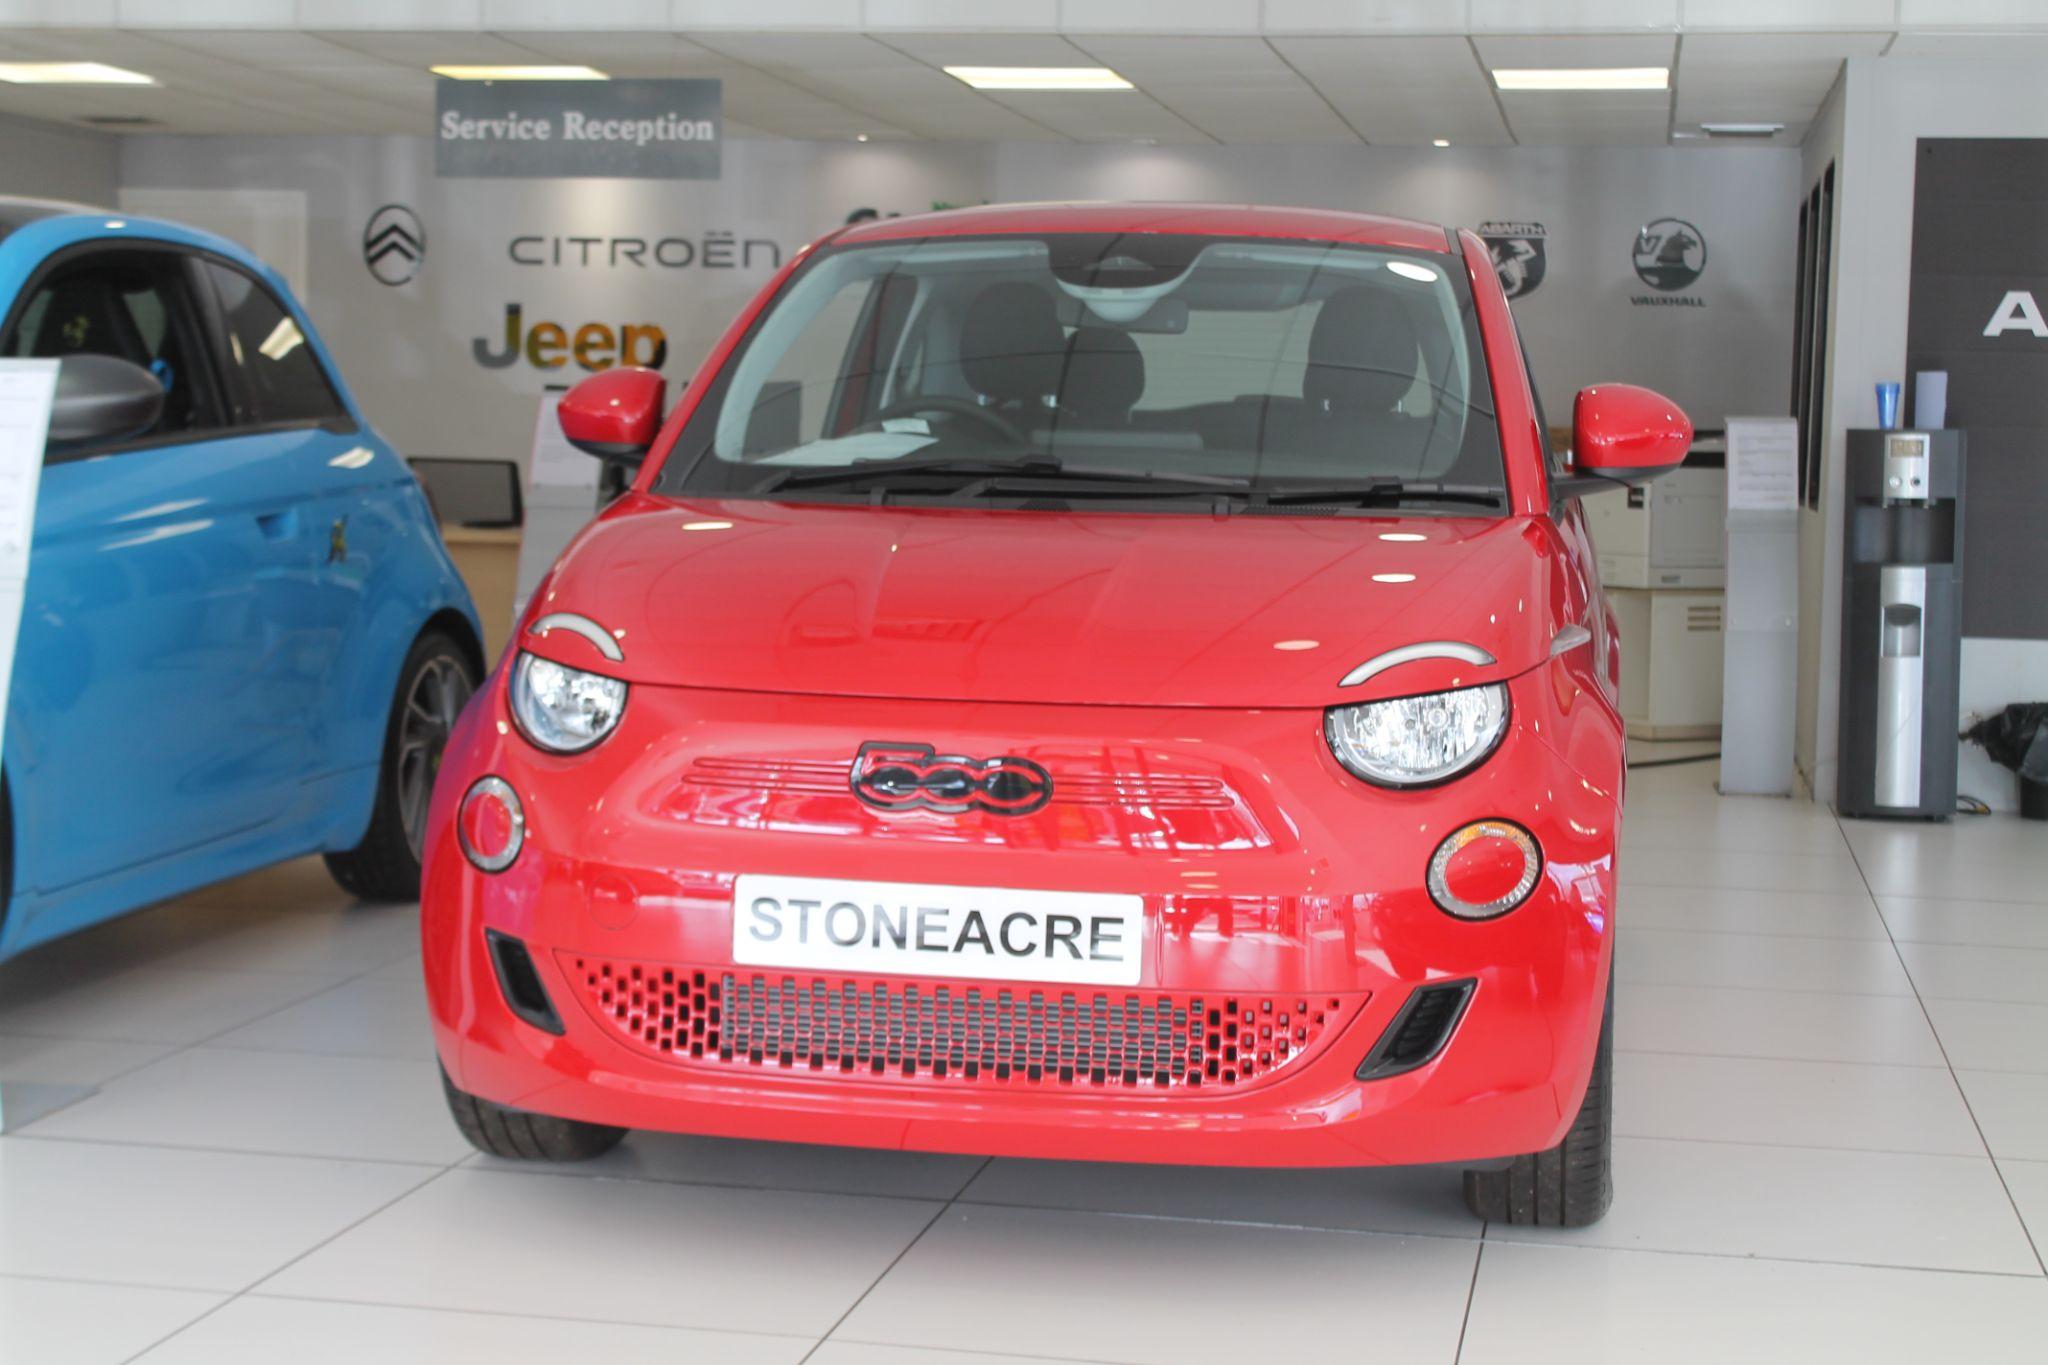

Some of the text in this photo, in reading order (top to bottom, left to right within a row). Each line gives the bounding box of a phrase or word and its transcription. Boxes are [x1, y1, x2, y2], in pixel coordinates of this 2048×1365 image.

[441, 110, 715, 146] Service Reception
[1481, 222, 1544, 236] ABARTH
[509, 230, 781, 269] CITROËN
[1630, 296, 1706, 308] VAUXHALL
[472, 303, 668, 372] Jeep
[748, 897, 1124, 962] STONEACRE
